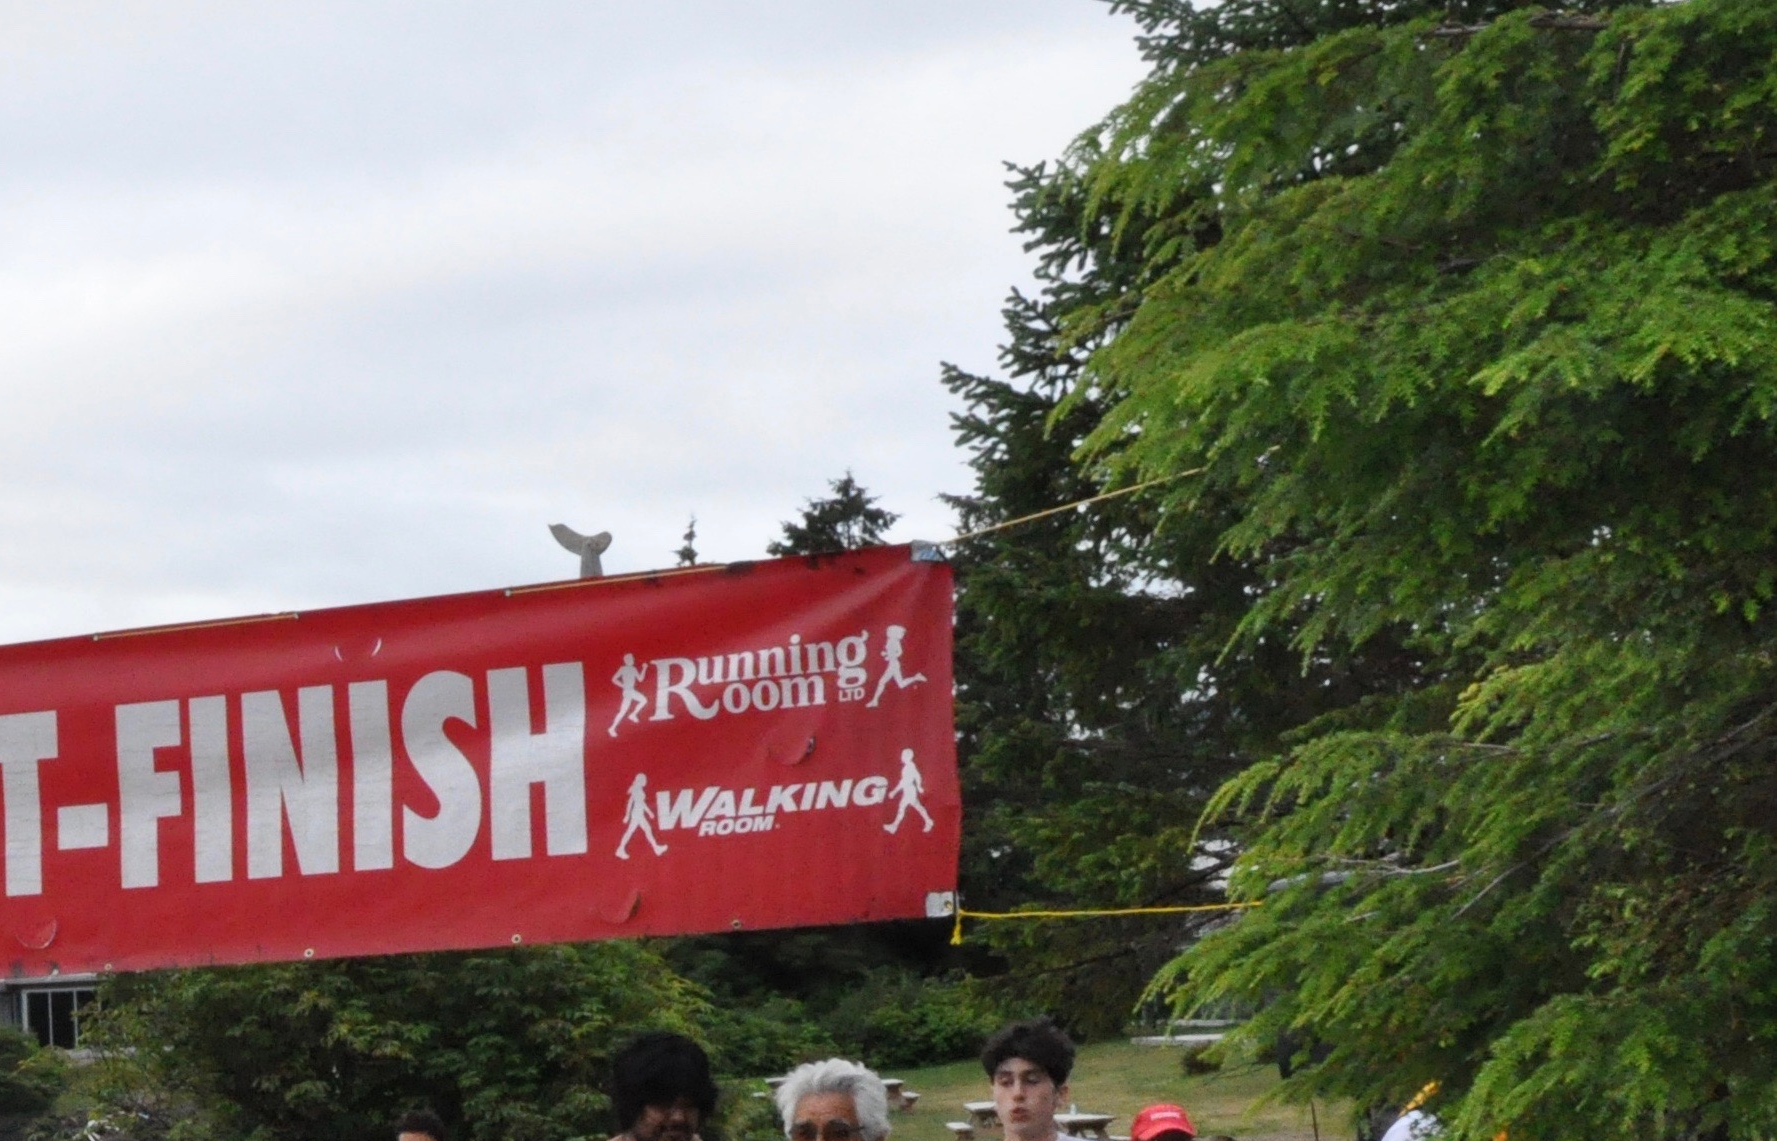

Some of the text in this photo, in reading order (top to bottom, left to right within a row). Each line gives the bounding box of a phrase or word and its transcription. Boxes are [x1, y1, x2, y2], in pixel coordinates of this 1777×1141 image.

[649, 630, 869, 721] Running
[656, 775, 889, 831] WALKING
[698, 815, 776, 838] ROOM
